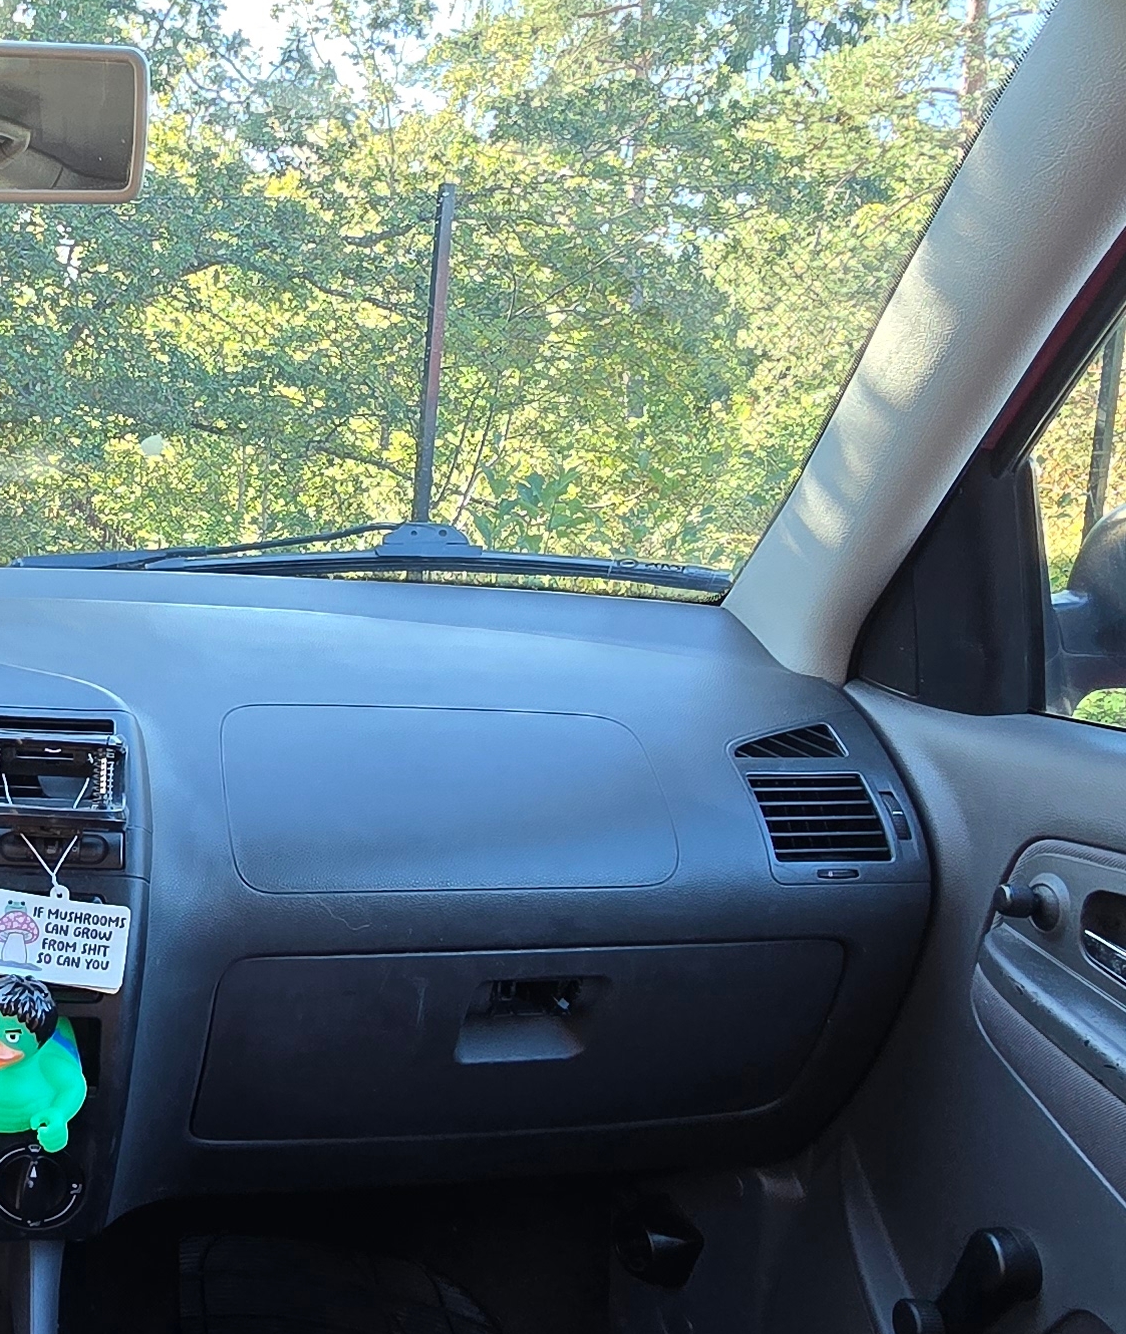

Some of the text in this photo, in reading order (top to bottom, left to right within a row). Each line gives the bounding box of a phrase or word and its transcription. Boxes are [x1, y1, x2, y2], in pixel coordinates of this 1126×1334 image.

[33, 906, 127, 928] IF MUSHROOMS
[44, 922, 113, 941] CAN GROW
[42, 938, 110, 957] FROM SHIT
[36, 952, 110, 970] SO CAN YOU
